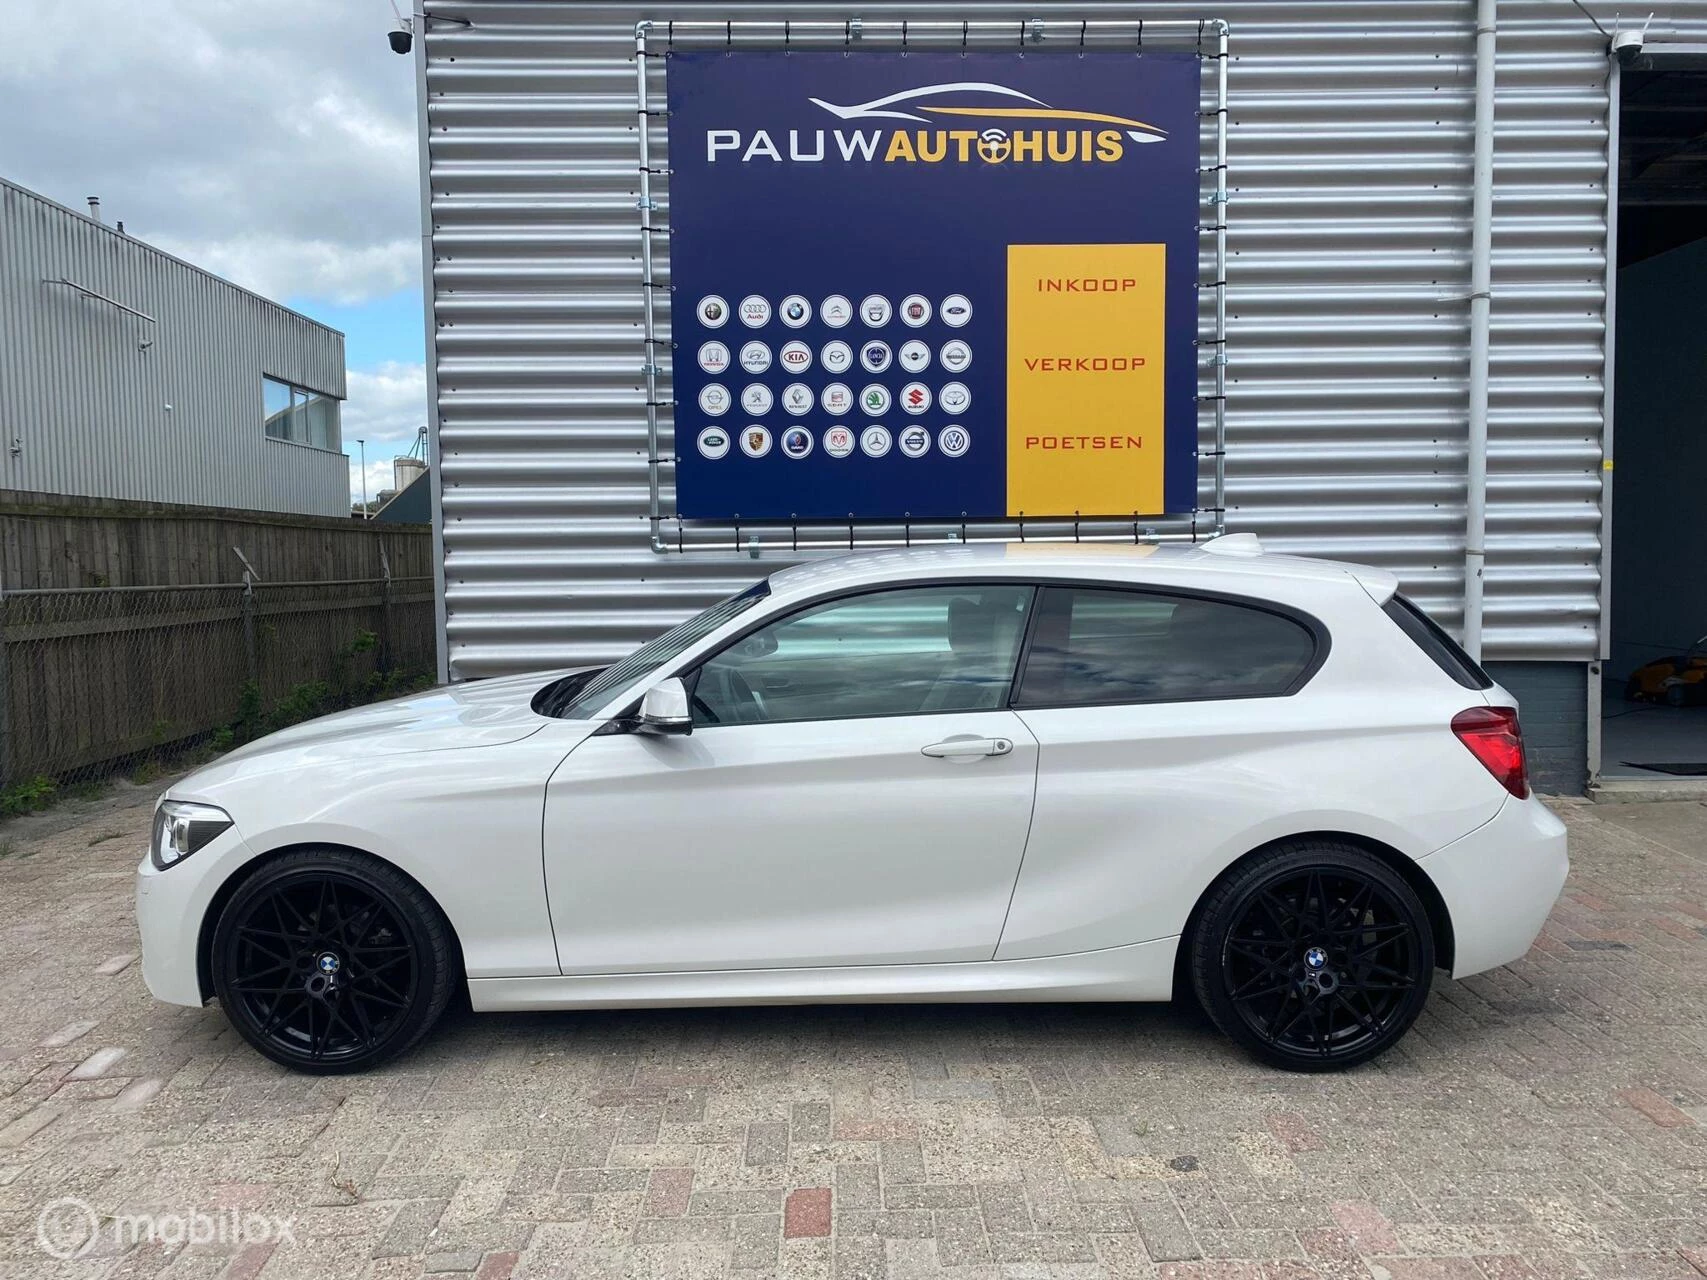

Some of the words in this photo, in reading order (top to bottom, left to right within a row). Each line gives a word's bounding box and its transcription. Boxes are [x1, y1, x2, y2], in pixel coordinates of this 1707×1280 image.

[1038, 279, 1136, 292] INKOOP
[788, 353, 805, 361] KIA
[1024, 358, 1146, 372] VERKOOP
[1025, 436, 1143, 450] POETSEN
